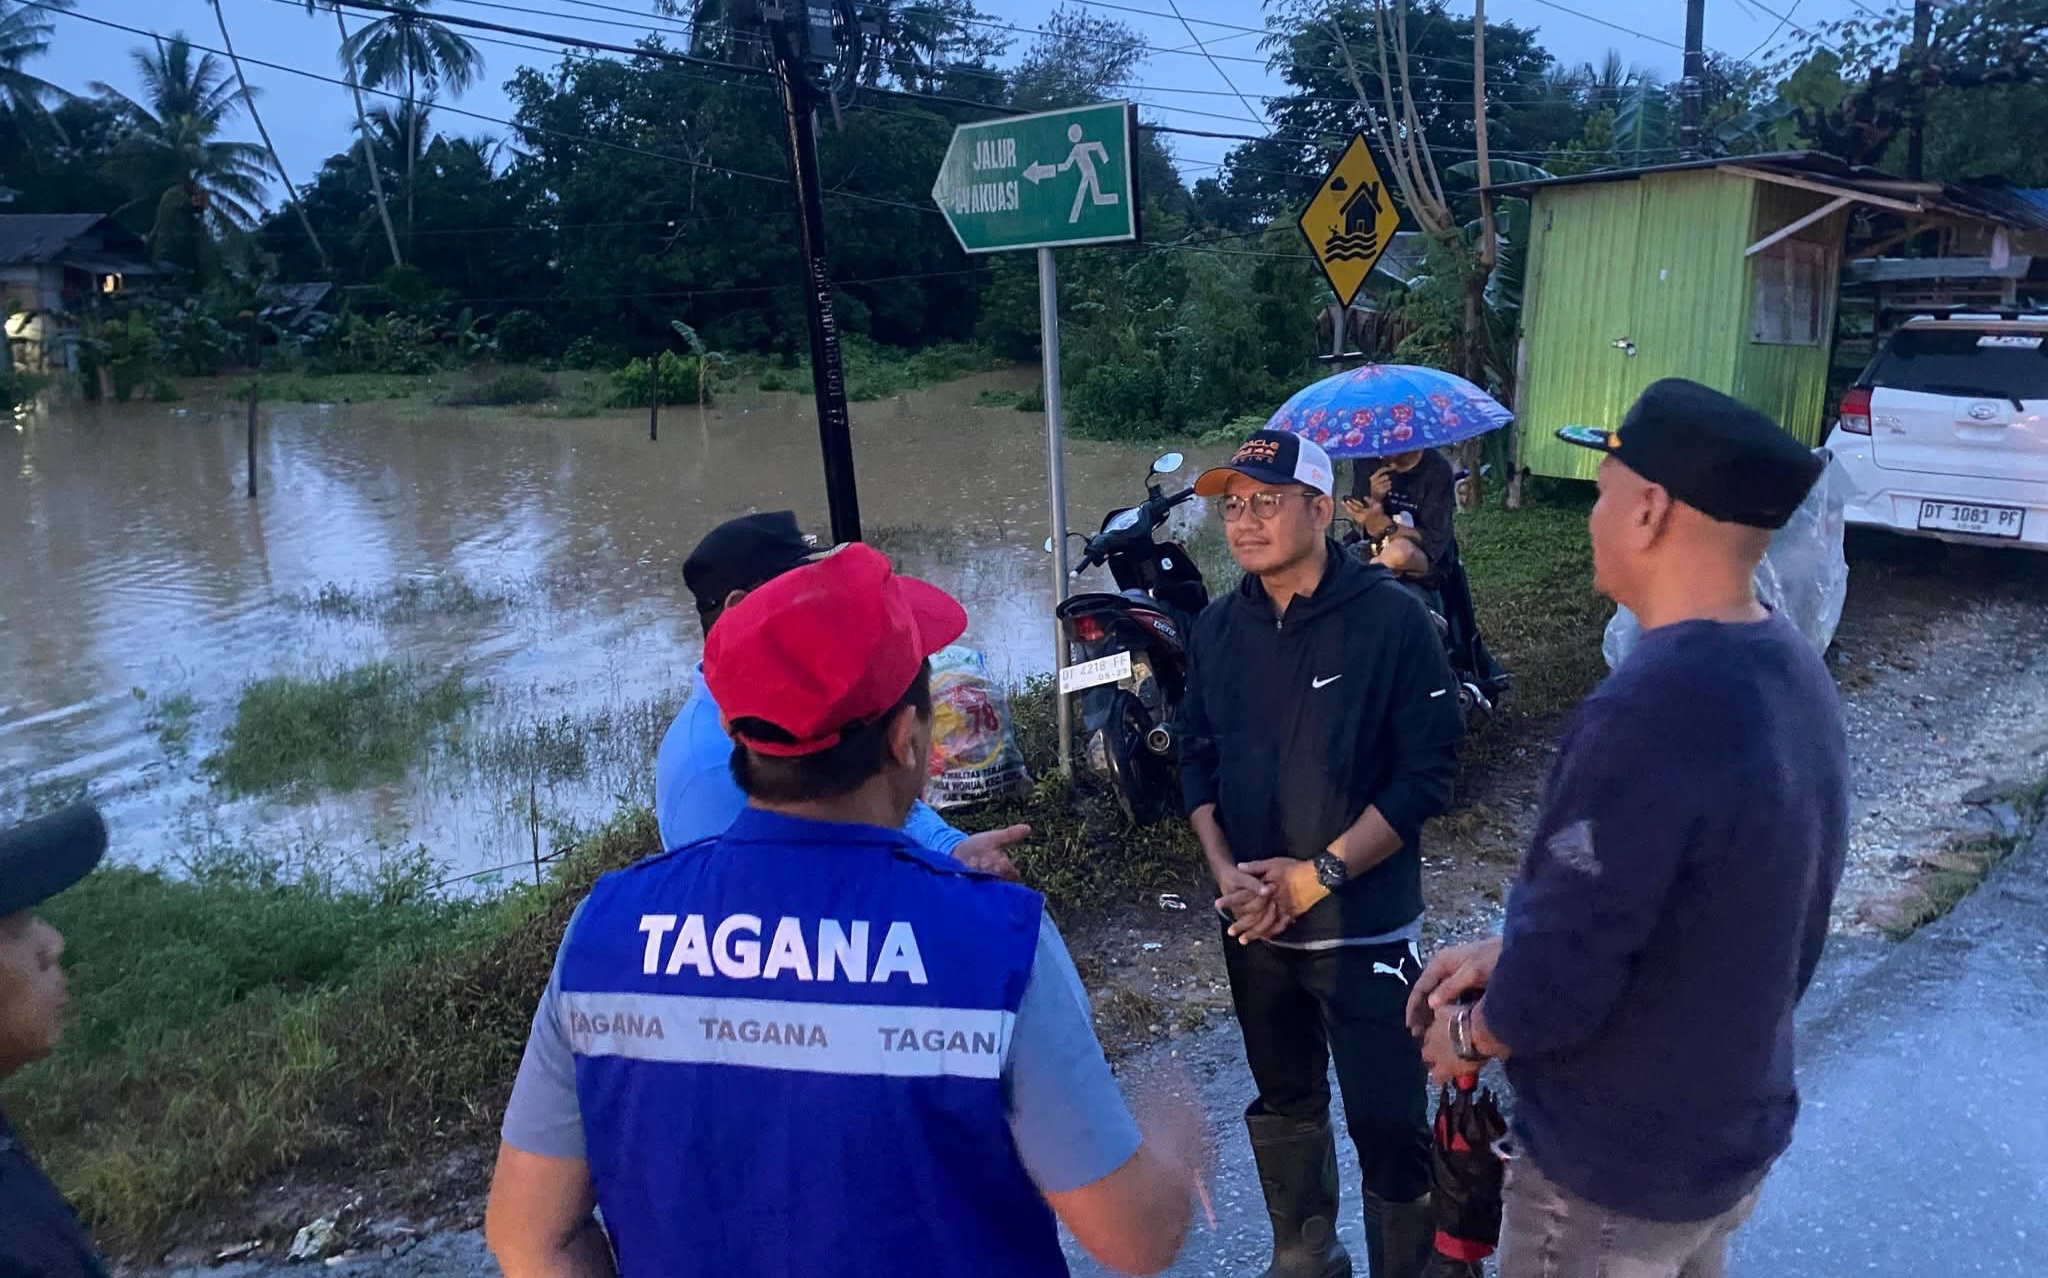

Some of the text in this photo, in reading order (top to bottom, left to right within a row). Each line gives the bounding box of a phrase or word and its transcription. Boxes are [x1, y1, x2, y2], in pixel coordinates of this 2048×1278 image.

[973, 138, 1017, 170] JALUR
[1924, 504, 1944, 519] DT
[1998, 511, 2018, 526] PF
[1113, 654, 1127, 668] FF
[638, 913, 928, 985] TAGANA
[699, 1017, 829, 1048] TAGANA
[878, 1027, 1001, 1055] TAGAN
